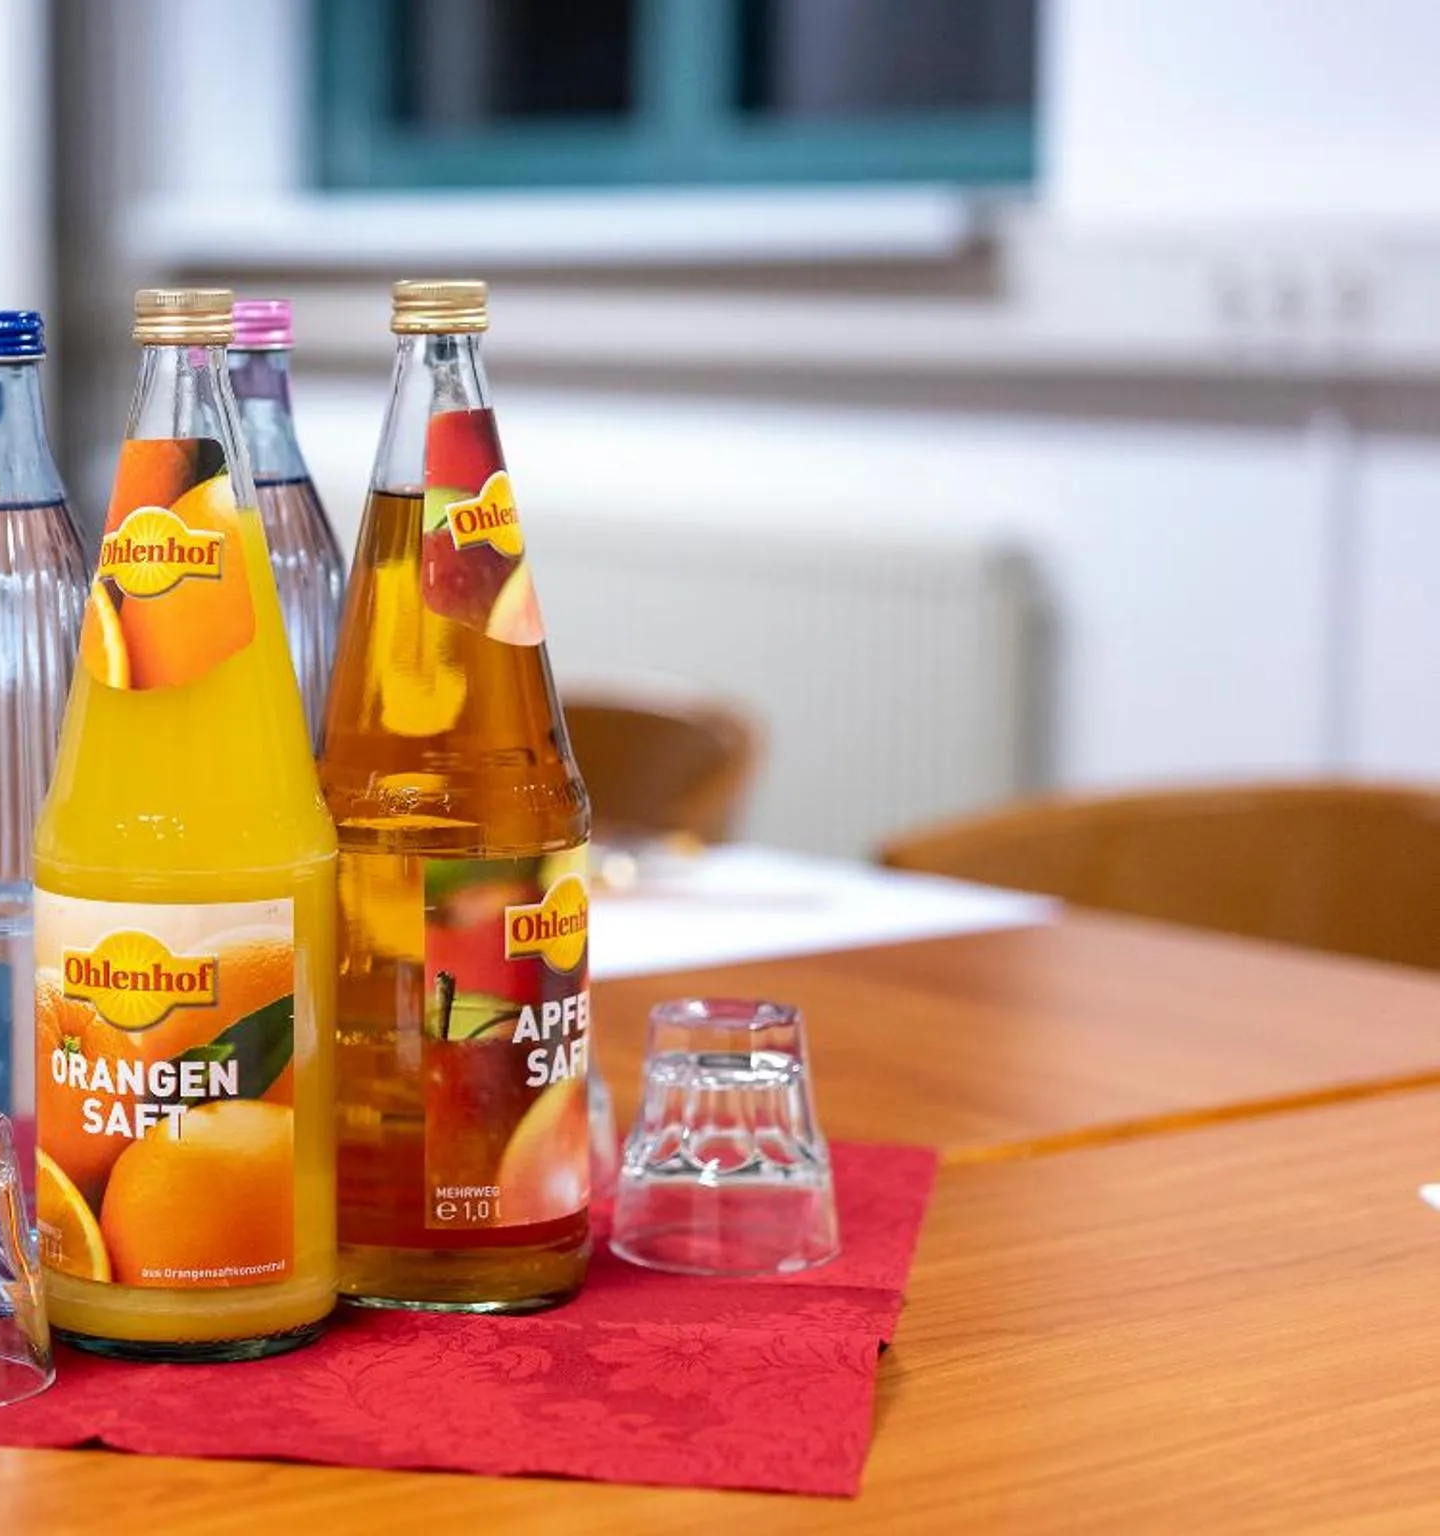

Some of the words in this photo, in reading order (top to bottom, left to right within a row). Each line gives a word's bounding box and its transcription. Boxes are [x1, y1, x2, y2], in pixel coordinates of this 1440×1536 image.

[101, 537, 220, 567] Ohlenhof
[64, 957, 215, 993] Ohlenhof
[51, 1048, 239, 1097] ORANGEN
[81, 1097, 188, 1140] SAFT
[435, 1185, 501, 1199] MEHRWEG
[463, 1200, 489, 1222] 1,0
